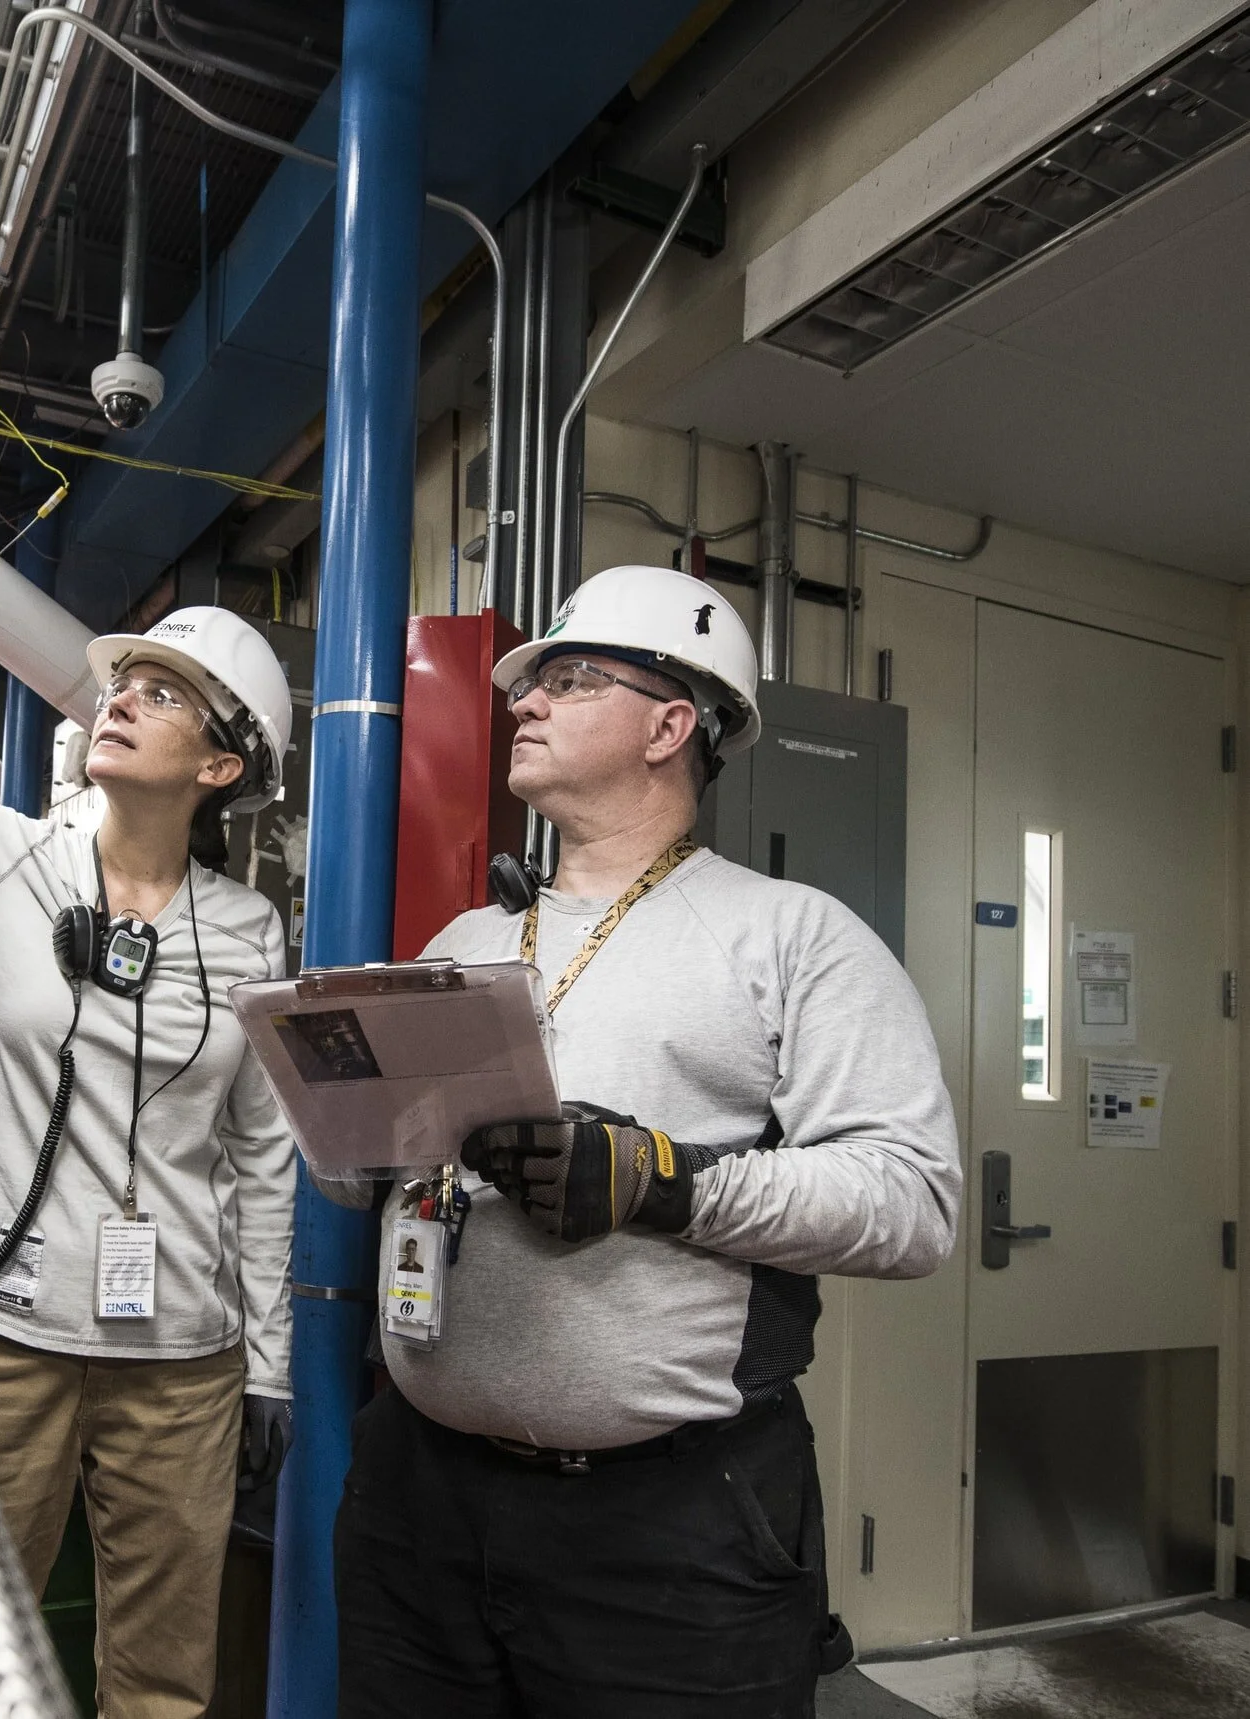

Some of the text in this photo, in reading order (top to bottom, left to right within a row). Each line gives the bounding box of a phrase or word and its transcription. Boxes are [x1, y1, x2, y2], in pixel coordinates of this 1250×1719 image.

[164, 623, 196, 633] NREL
[991, 909, 1004, 920] 127
[115, 1303, 146, 1313] NREL
